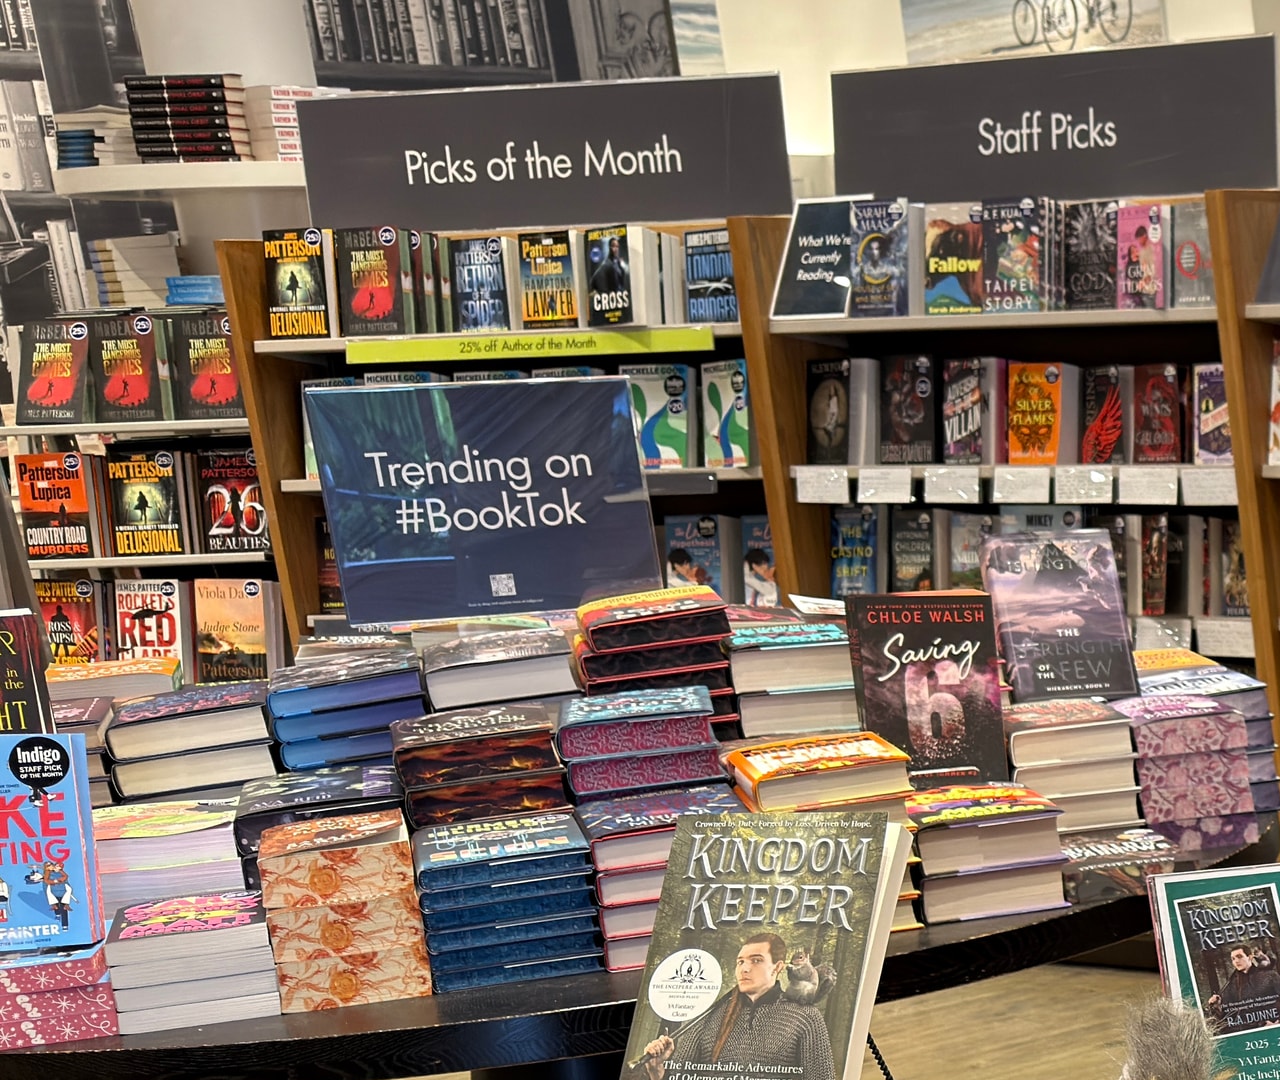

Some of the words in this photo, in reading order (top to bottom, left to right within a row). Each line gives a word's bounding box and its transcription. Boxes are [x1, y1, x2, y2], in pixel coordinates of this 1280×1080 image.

[978, 111, 1042, 155] Staff
[1051, 106, 1117, 150] Picks
[405, 145, 477, 184] Picks
[487, 142, 516, 181] of
[525, 140, 572, 179] the
[584, 134, 682, 176] Month
[799, 236, 823, 247] What
[826, 234, 851, 246] We're
[801, 252, 842, 266] Currently
[929, 257, 981, 273] Fallow
[796, 269, 834, 283] Reading
[985, 278, 1034, 293] TAIPEI
[593, 291, 629, 311] CROSS
[985, 296, 1033, 311] STORY
[270, 311, 327, 336] DELUSIONAL
[459, 341, 481, 353] 25%
[484, 340, 498, 352] off
[501, 340, 532, 351] Author
[536, 339, 545, 350] of
[549, 338, 562, 350] the
[566, 336, 596, 349] Month
[1016, 400, 1051, 411] SILVER
[1012, 414, 1054, 425] FLAMES
[364, 445, 533, 491] Trending
[545, 453, 592, 478] on
[396, 487, 587, 534] #BookTok
[27, 526, 63, 546] COUNTRY
[65, 526, 87, 544] ROAD
[28, 544, 89, 555] MURDERS
[867, 611, 922, 624] CHLOE
[929, 610, 985, 623] WALSH
[200, 621, 229, 633] Judge
[231, 622, 260, 633] Stone
[878, 632, 980, 682] Saving
[682, 834, 873, 879] KINGDOM
[681, 883, 854, 932] KEEPER
[664, 1060, 682, 1070] The
[684, 1061, 744, 1072] Remarkable
[747, 1063, 804, 1074] Adventures
[1238, 1056, 1252, 1067] YA
